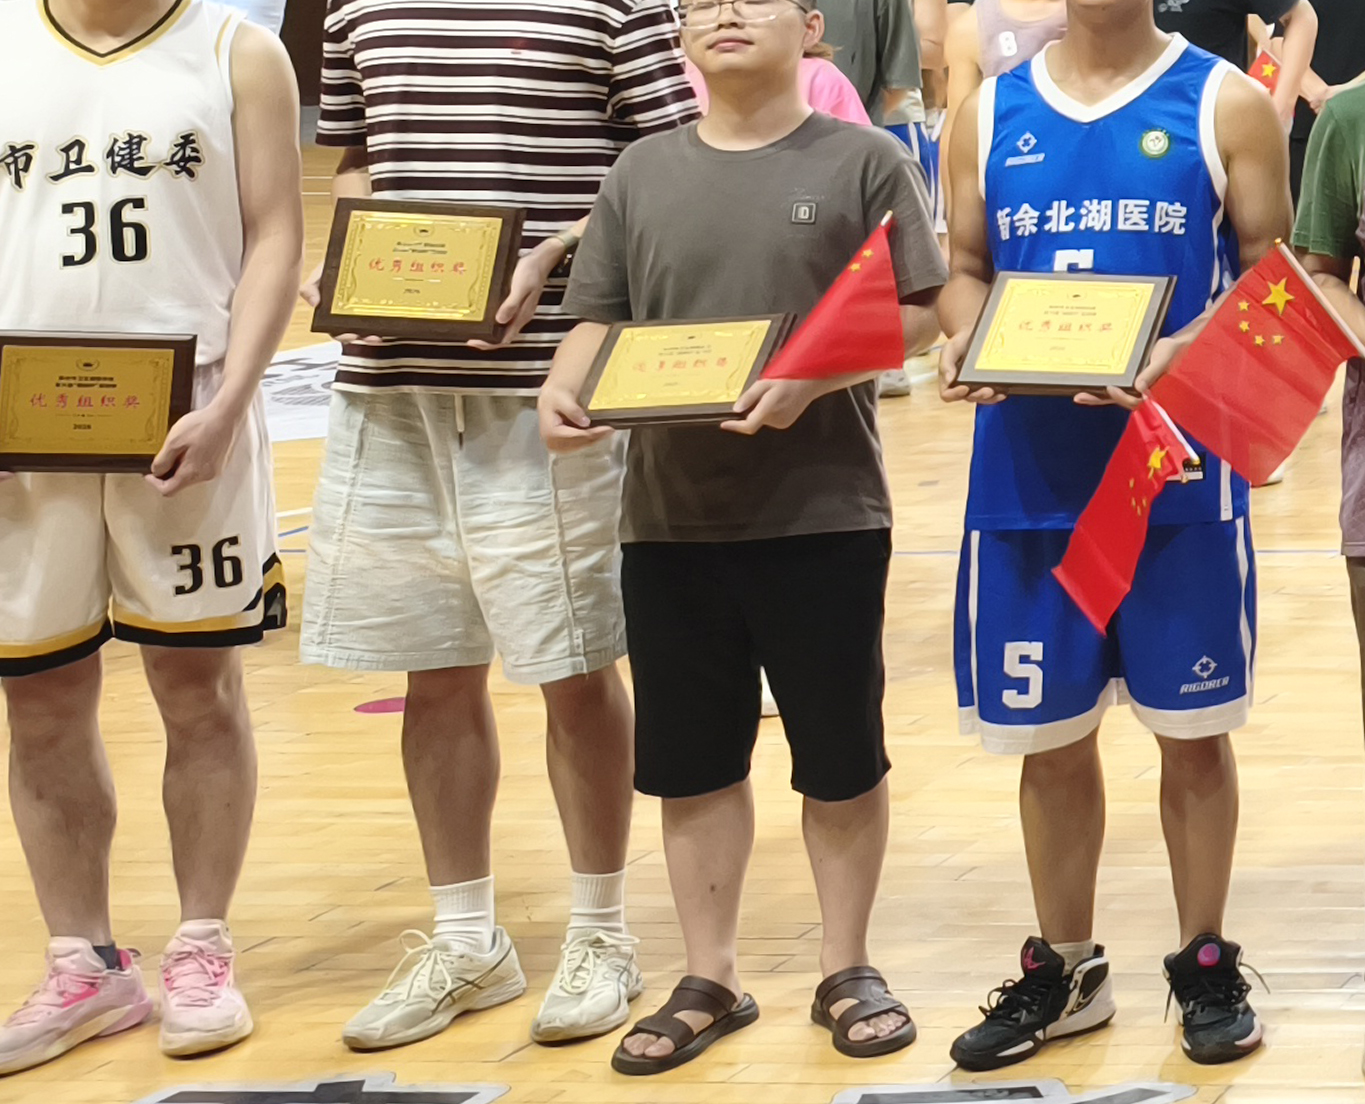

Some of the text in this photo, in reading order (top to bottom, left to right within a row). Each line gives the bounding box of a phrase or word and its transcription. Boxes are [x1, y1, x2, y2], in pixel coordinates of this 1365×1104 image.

[999, 31, 1018, 57] 8
[0, 132, 203, 189] 市卫健委
[61, 197, 148, 267] 36
[171, 535, 243, 595] 36
[1002, 641, 1044, 709] 5
